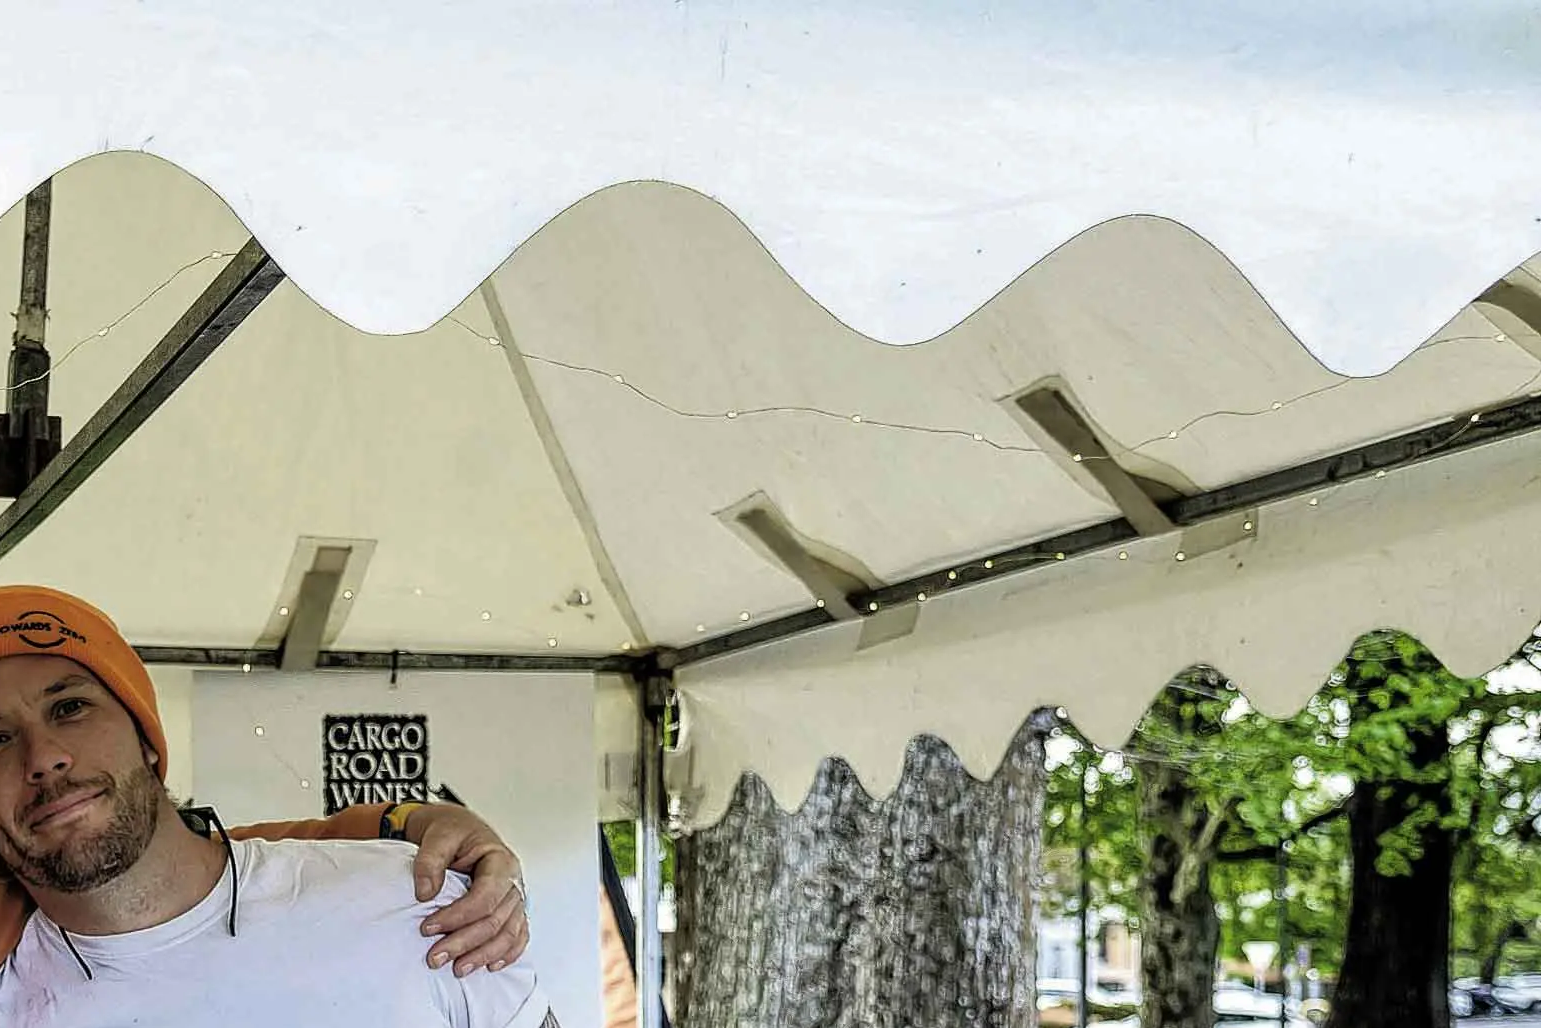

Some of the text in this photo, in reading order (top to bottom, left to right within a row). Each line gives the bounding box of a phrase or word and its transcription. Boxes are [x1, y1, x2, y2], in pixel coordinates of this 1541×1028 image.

[327, 720, 425, 750] CARGO
[330, 750, 425, 780] ROAD
[329, 781, 425, 808] WINES
